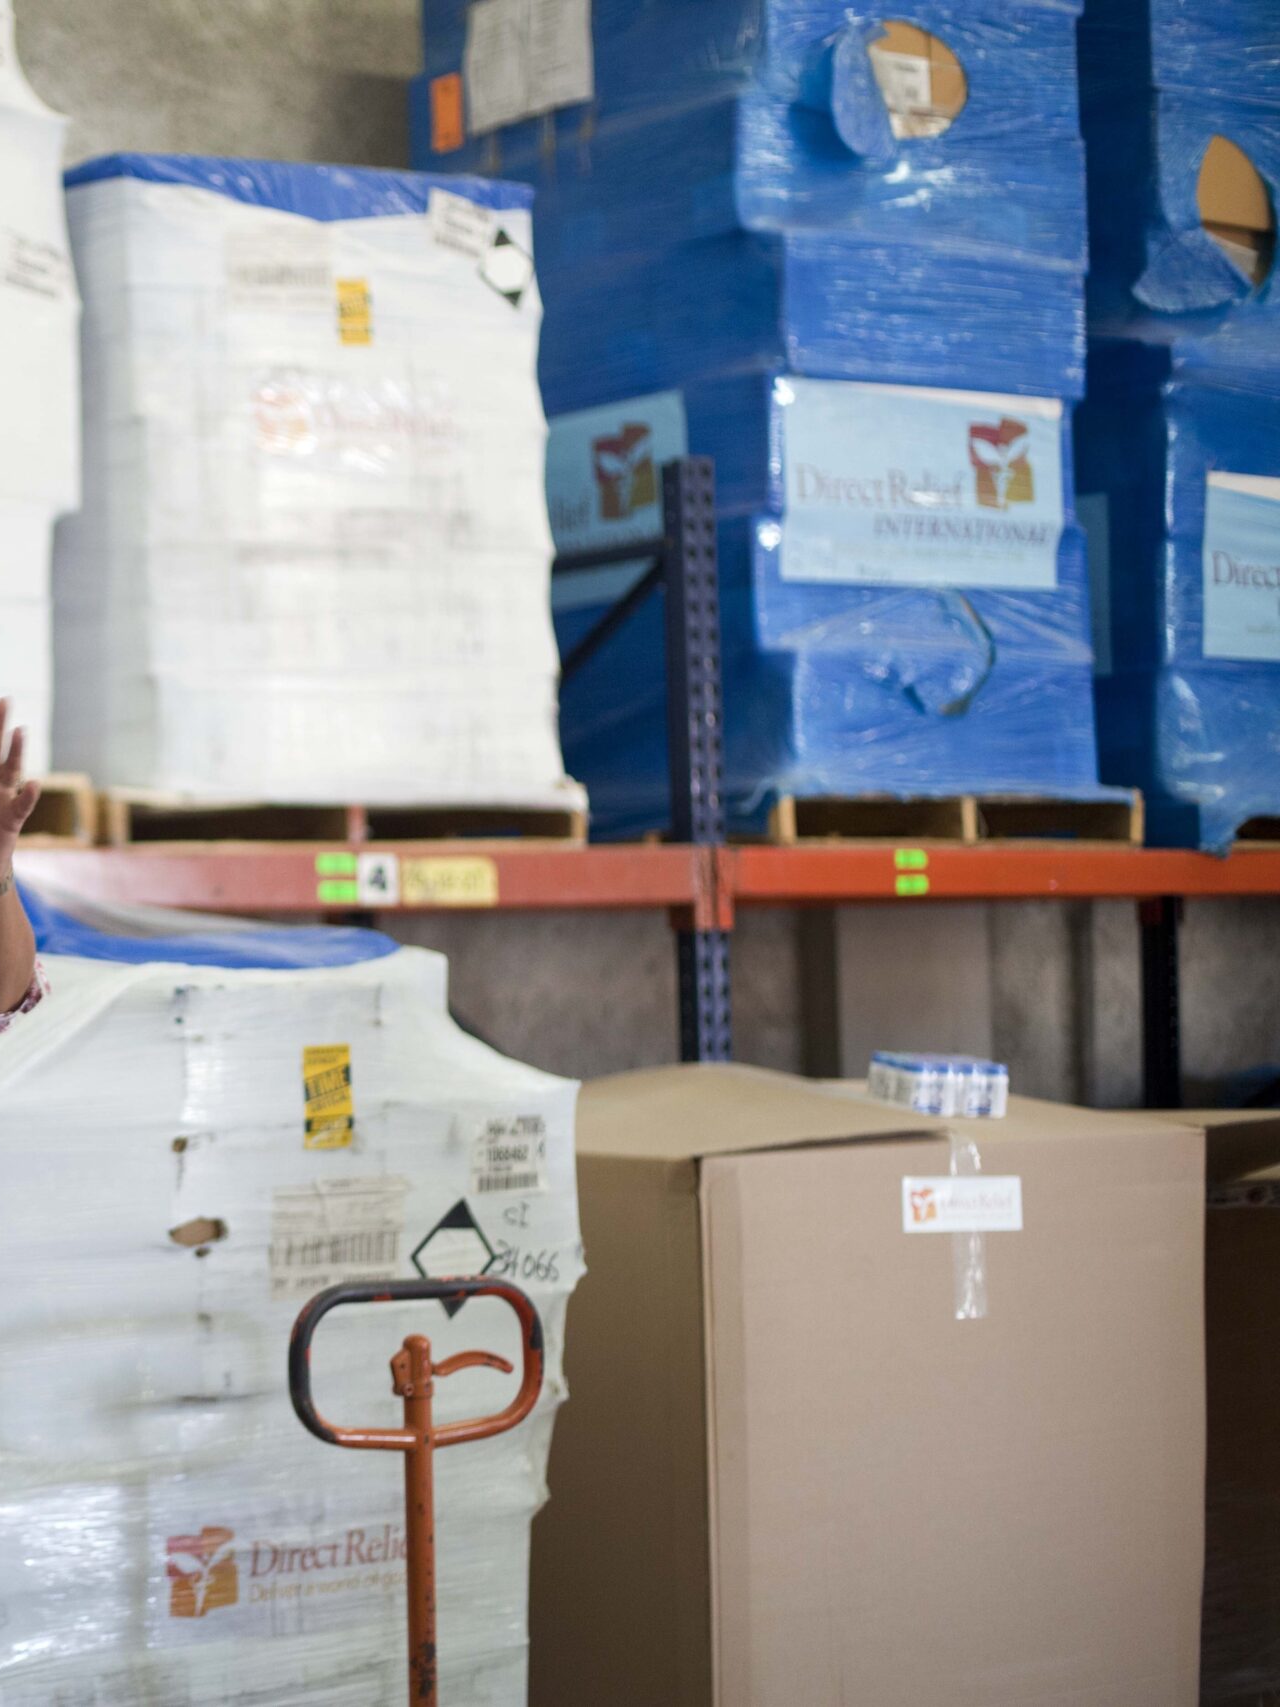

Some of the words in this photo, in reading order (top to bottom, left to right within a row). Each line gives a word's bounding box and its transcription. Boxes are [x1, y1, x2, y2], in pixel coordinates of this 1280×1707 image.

[794, 462, 882, 503] Direct
[872, 514, 1051, 546] INTERNATIONAL
[250, 1540, 341, 1577] Direct
